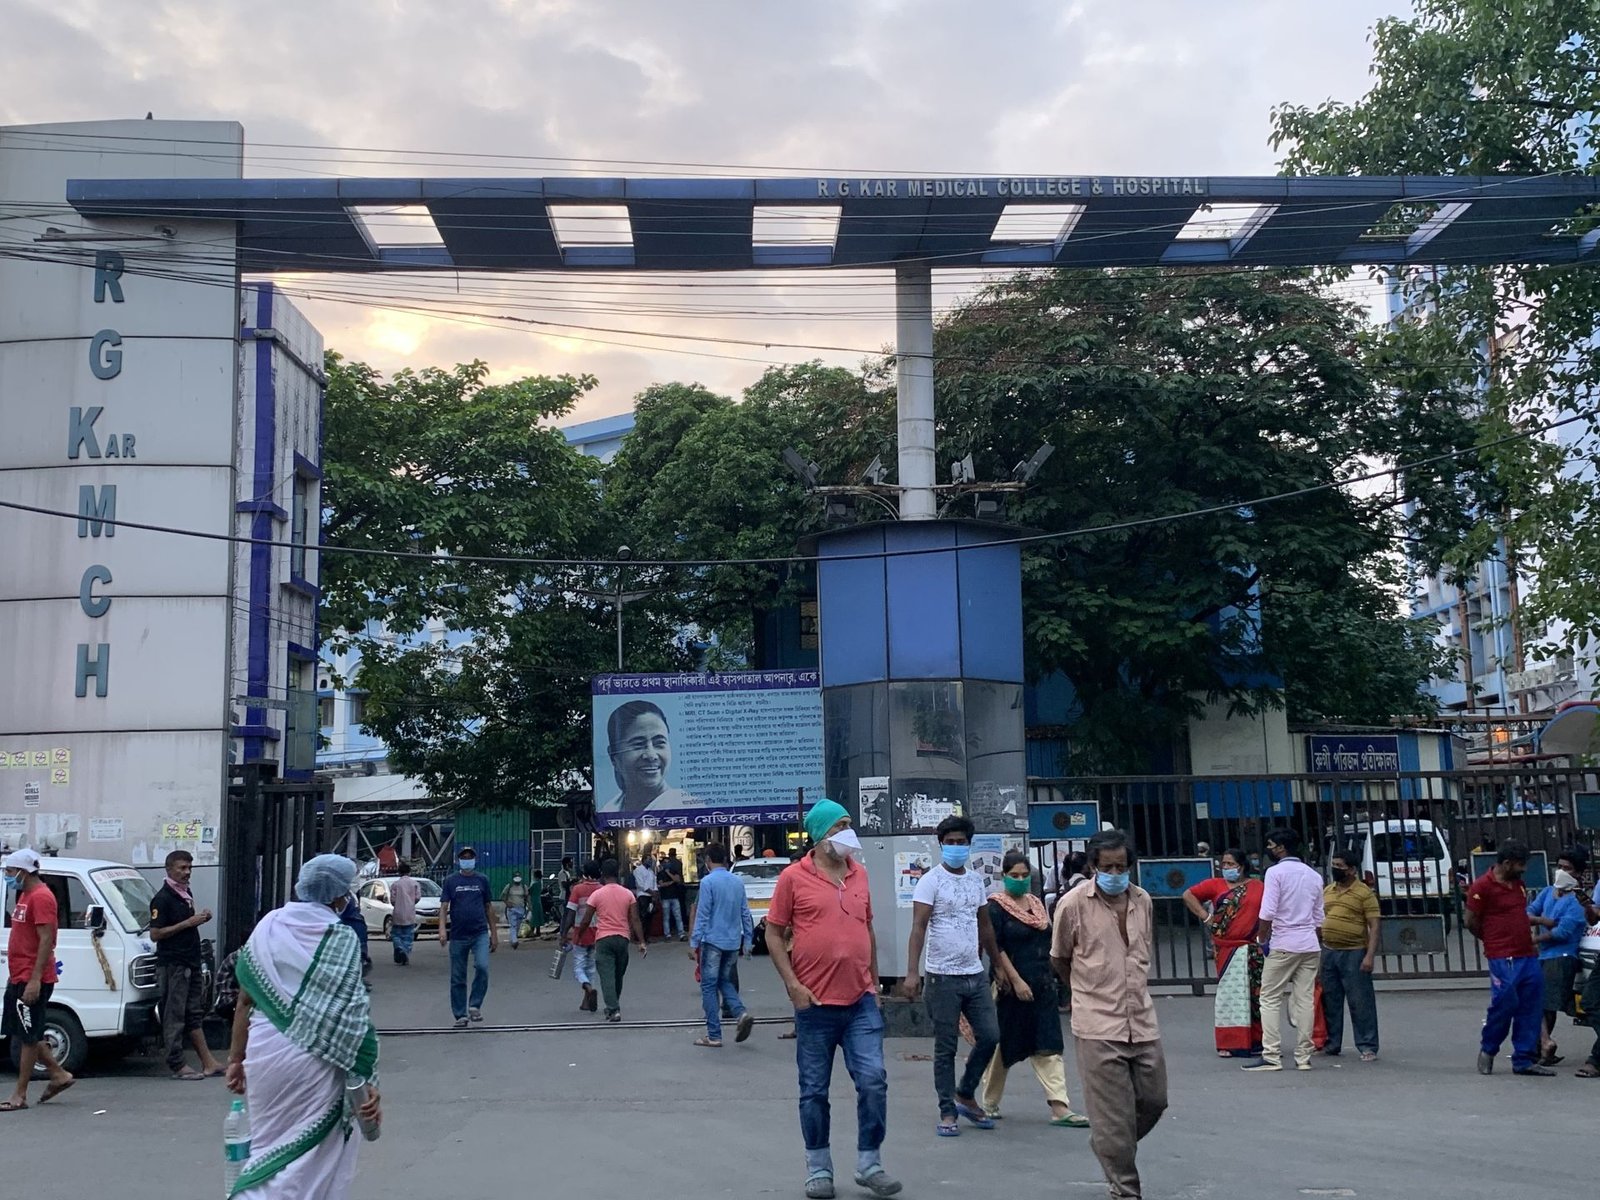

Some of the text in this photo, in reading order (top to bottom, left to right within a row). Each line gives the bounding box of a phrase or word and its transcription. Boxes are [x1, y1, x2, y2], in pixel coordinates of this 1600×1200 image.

[908, 178, 988, 197] MEDICAL
[997, 178, 1082, 196] COLLEGE
[1091, 178, 1104, 195] &
[1112, 178, 1205, 196] HOSPITAL
[94, 250, 125, 303] R
[89, 328, 123, 380] G
[77, 485, 116, 537] M
[79, 564, 113, 618] C
[75, 643, 109, 698] H
[598, 675, 611, 691] পূর্ব
[613, 678, 640, 689] ভারতে
[641, 677, 660, 688] প্রথম
[708, 675, 721, 686] এই
[723, 674, 762, 686] হাসপাতাল
[1333, 743, 1359, 771] পরিজন
[608, 819, 637, 828] আর
[642, 815, 660, 827] জি
[666, 815, 688, 826] কর
[694, 811, 761, 825] মেডিকেল
[151, 908, 158, 920] 3
